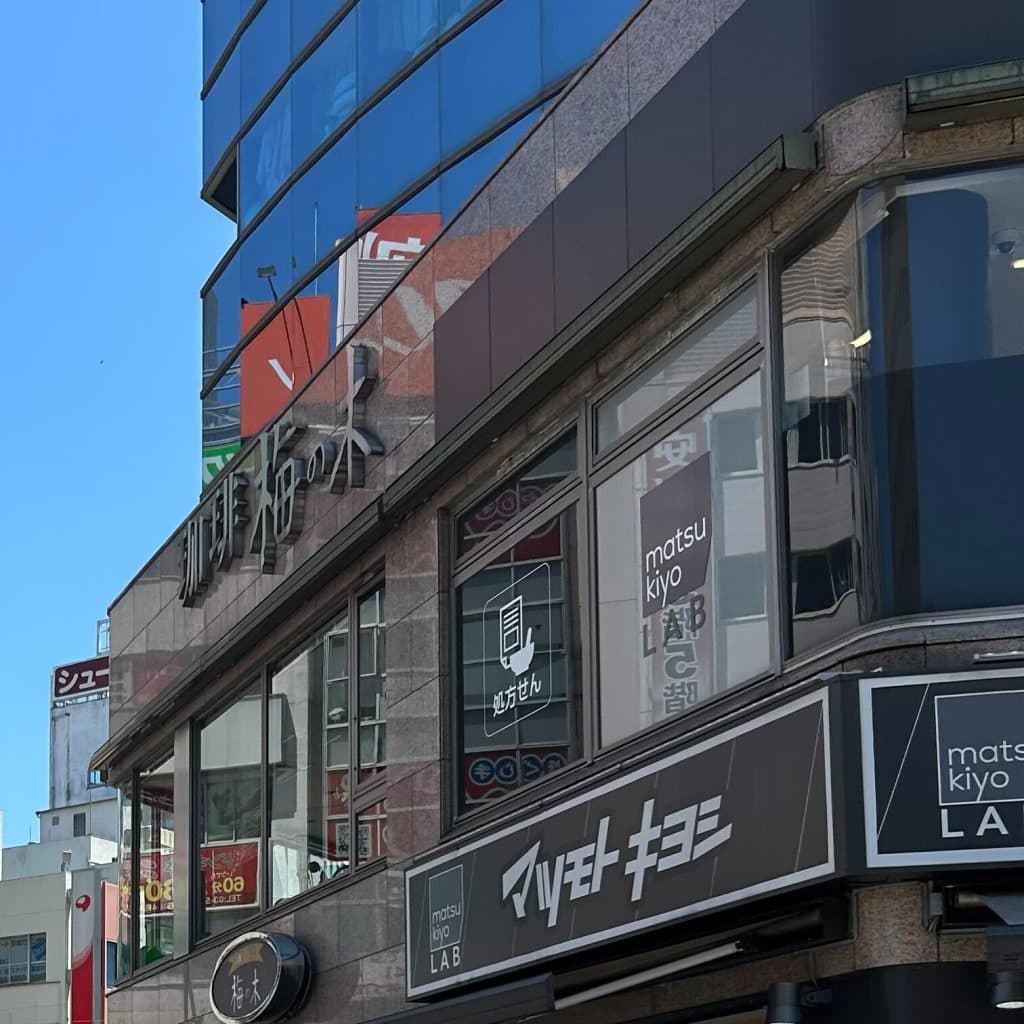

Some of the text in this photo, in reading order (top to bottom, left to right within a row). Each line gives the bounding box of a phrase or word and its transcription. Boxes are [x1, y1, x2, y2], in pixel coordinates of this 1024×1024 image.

[645, 516, 707, 574] matsu
[645, 564, 683, 608] kiyo
[492, 678, 542, 718] 処方せん
[949, 766, 1010, 803] kiyo
[941, 805, 1024, 839] LA
[502, 794, 733, 928] マツモトキヨシ
[432, 901, 462, 927] matsu
[432, 923, 450, 952] kiyo
[431, 947, 462, 974] LAB
